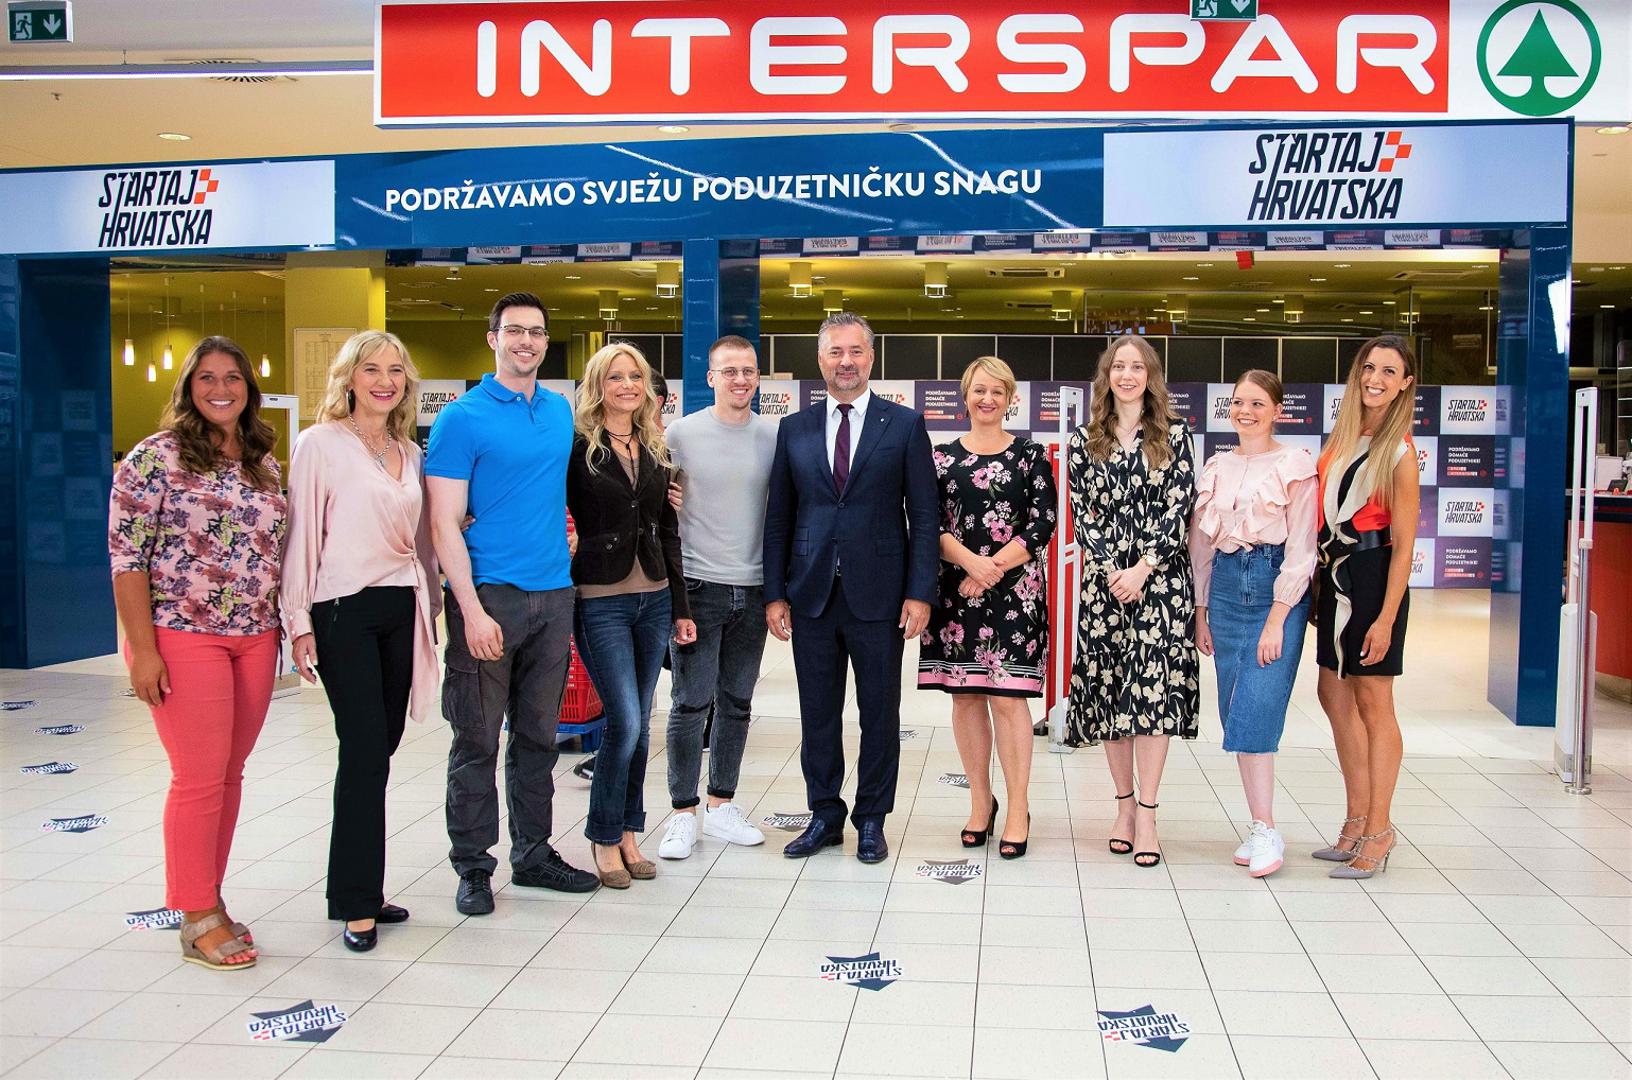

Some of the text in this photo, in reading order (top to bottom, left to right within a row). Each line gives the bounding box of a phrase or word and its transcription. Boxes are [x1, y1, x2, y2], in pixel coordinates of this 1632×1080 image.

[477, 14, 1436, 98] INTERSPAR
[1249, 131, 1385, 174] STARTAJ
[98, 169, 199, 208] STARTAJ
[386, 166, 1042, 212] PODRŽAVAMO SVJEŽU PODUZETNIČKU SNAGU
[1247, 178, 1403, 220] HRVATSKA
[98, 209, 212, 247] HRVATSKA
[421, 392, 451, 403] STARTAJ
[421, 404, 446, 414] HRVAT
[1448, 400, 1481, 410] STARTAJ
[1448, 411, 1486, 421] HRVATSKA
[1445, 513, 1483, 523] HRVATSKA
[1446, 502, 1478, 512] STARTAJ
